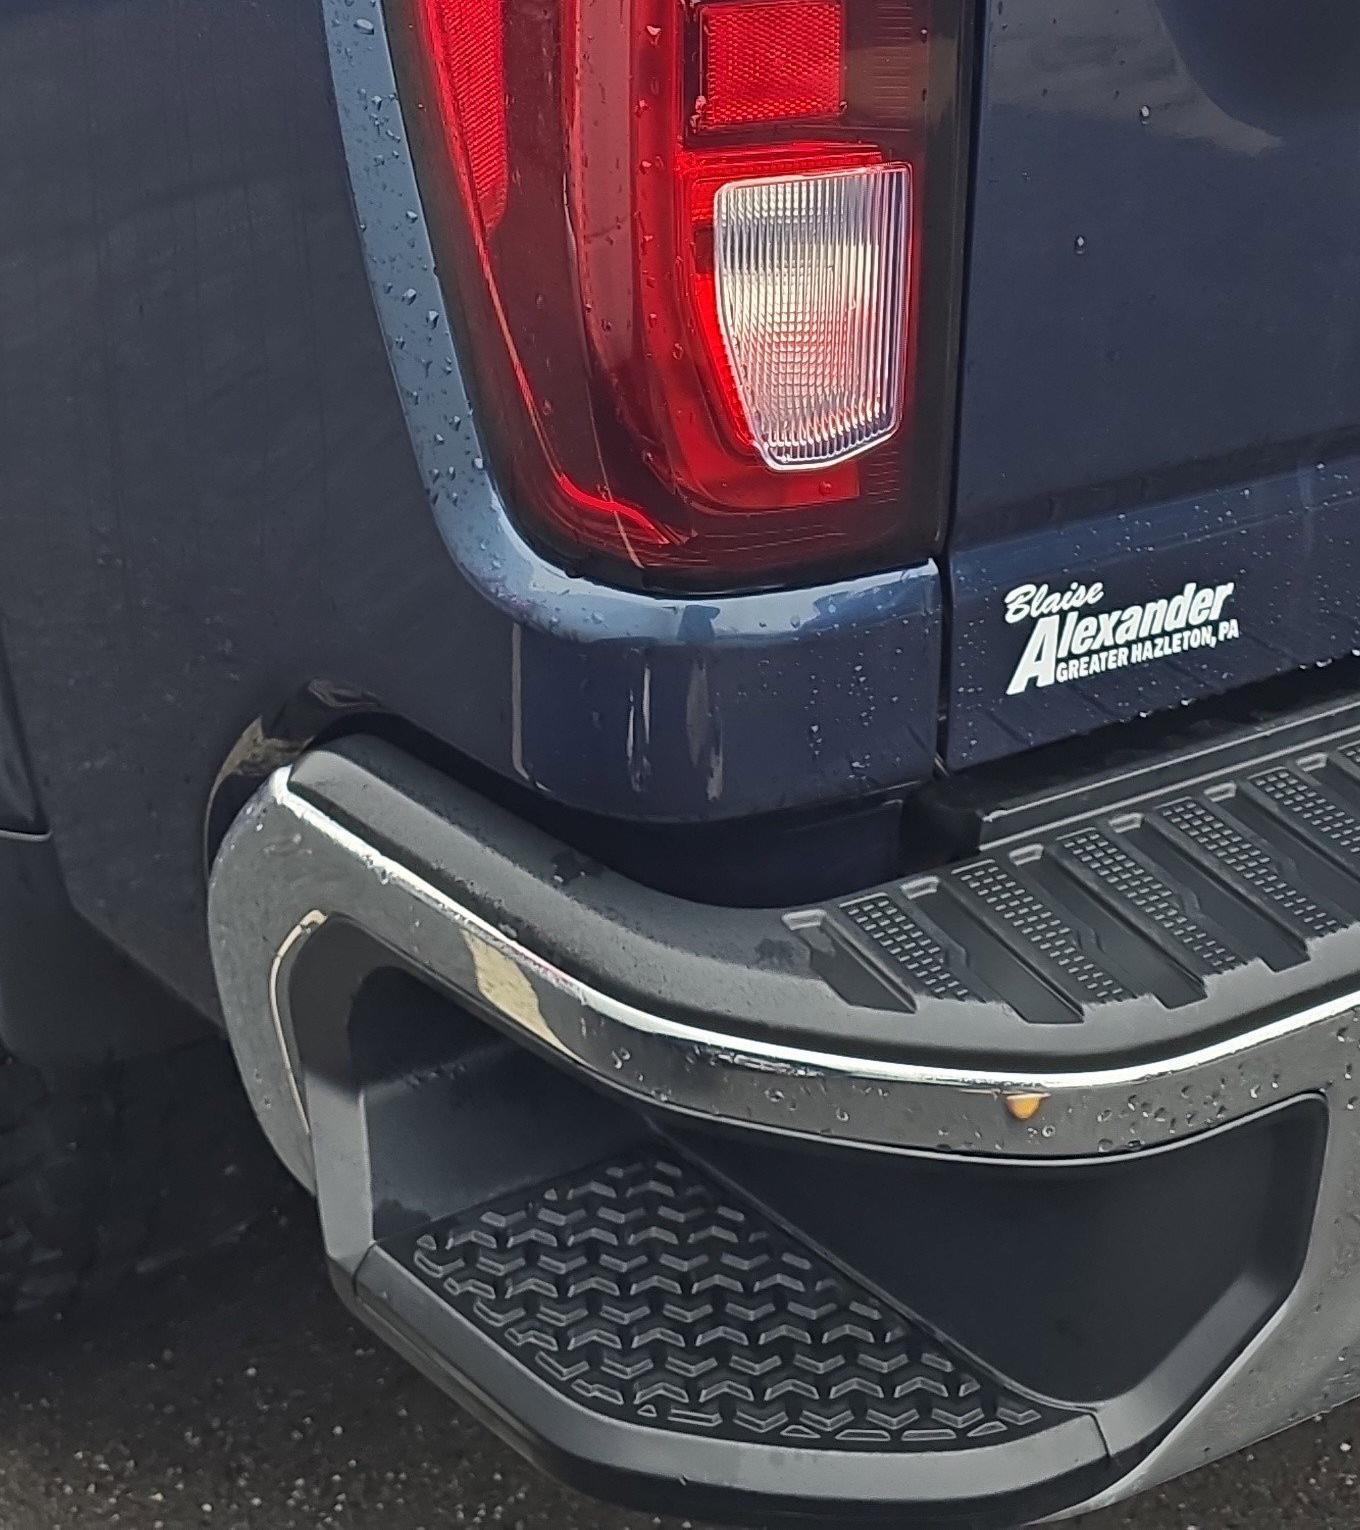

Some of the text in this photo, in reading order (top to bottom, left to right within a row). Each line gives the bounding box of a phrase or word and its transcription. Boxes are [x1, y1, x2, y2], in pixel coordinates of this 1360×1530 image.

[1003, 581, 1105, 624] Blaise
[1005, 582, 1236, 696] Alexander
[1055, 618, 1241, 684] GREATER HAZLETON, PA
